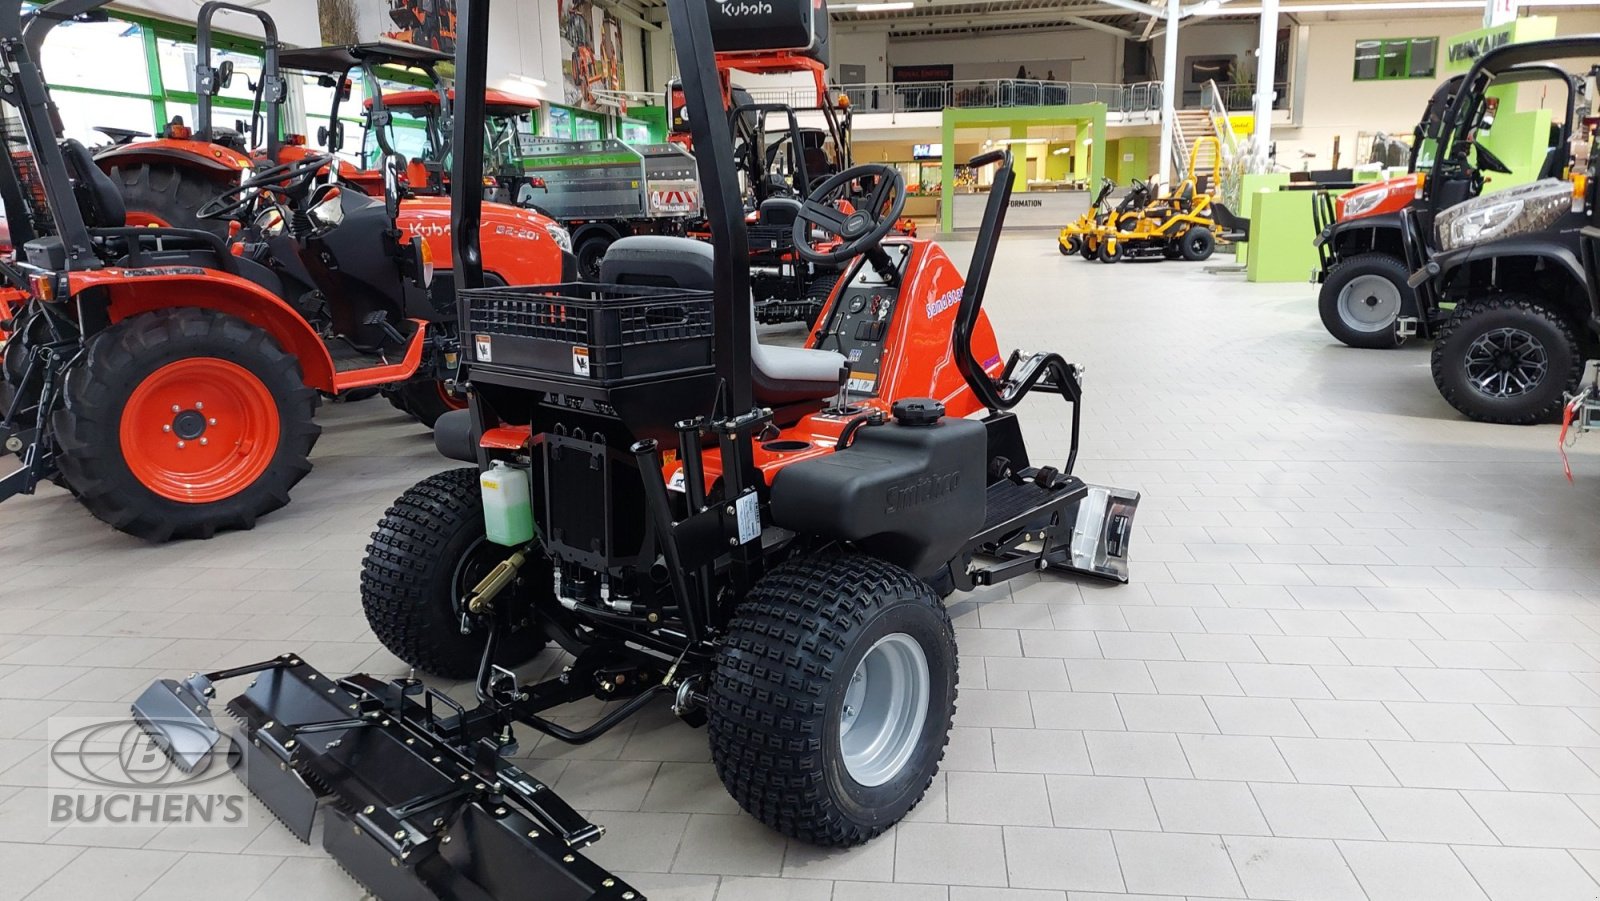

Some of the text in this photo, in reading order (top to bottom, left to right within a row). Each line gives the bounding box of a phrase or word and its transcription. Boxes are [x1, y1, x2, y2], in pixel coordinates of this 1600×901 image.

[721, 1, 773, 17] Kubota
[409, 222, 451, 239] Kubo
[885, 470, 961, 514] Smithco
